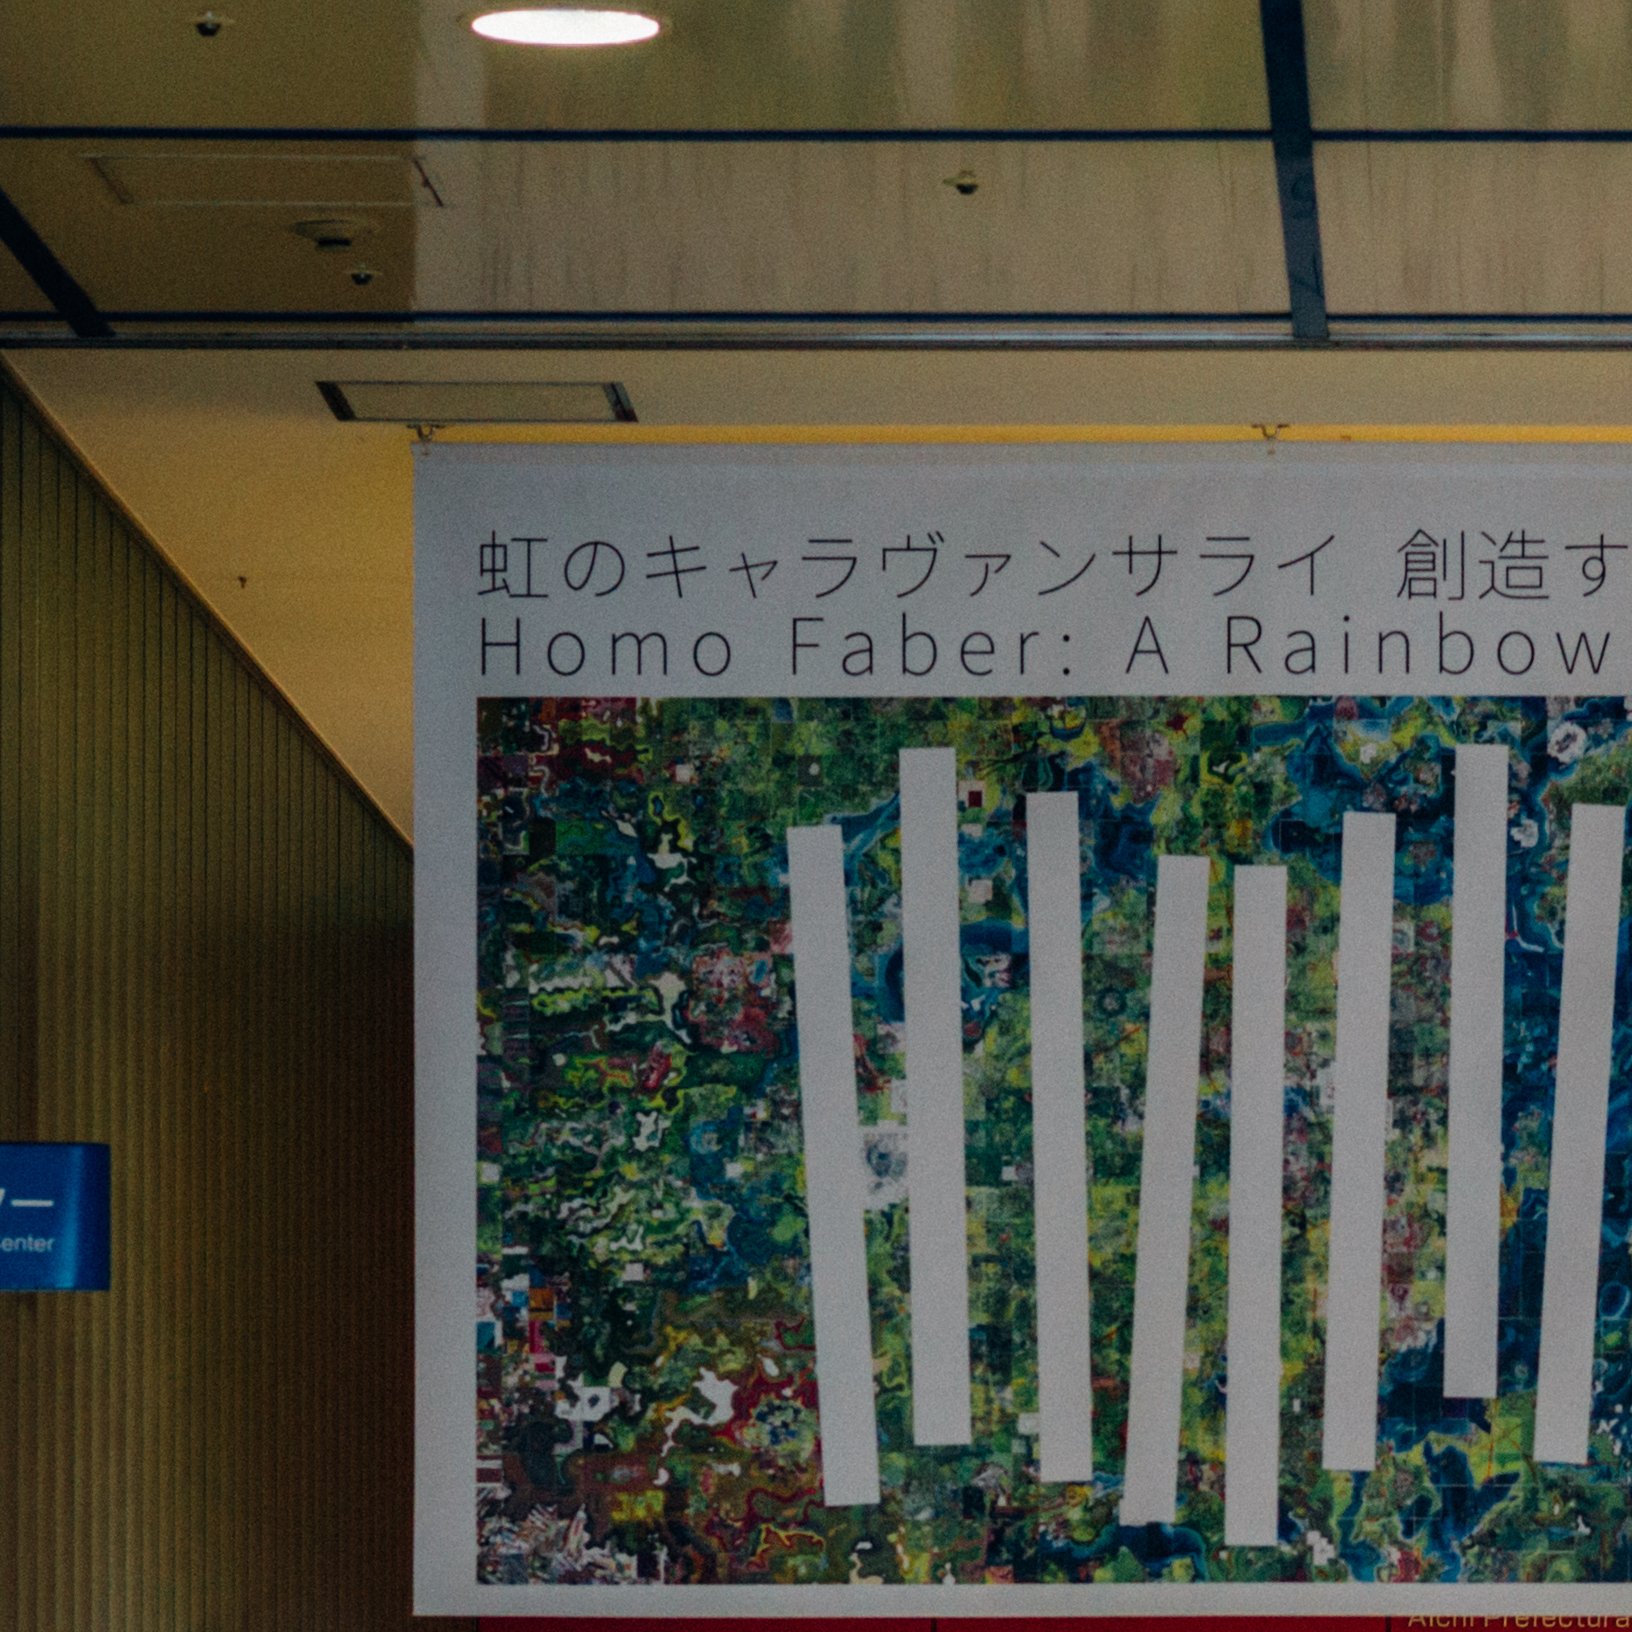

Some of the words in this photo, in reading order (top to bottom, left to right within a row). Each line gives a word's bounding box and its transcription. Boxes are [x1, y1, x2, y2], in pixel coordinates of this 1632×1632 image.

[477, 530, 1337, 600] 虹のキャラヴァンサライ
[479, 616, 733, 678] Homo
[789, 611, 1073, 678] Faber:
[1125, 616, 1170, 676] A
[1226, 611, 1612, 677] Rainbow
[0, 1233, 56, 1253] enter
